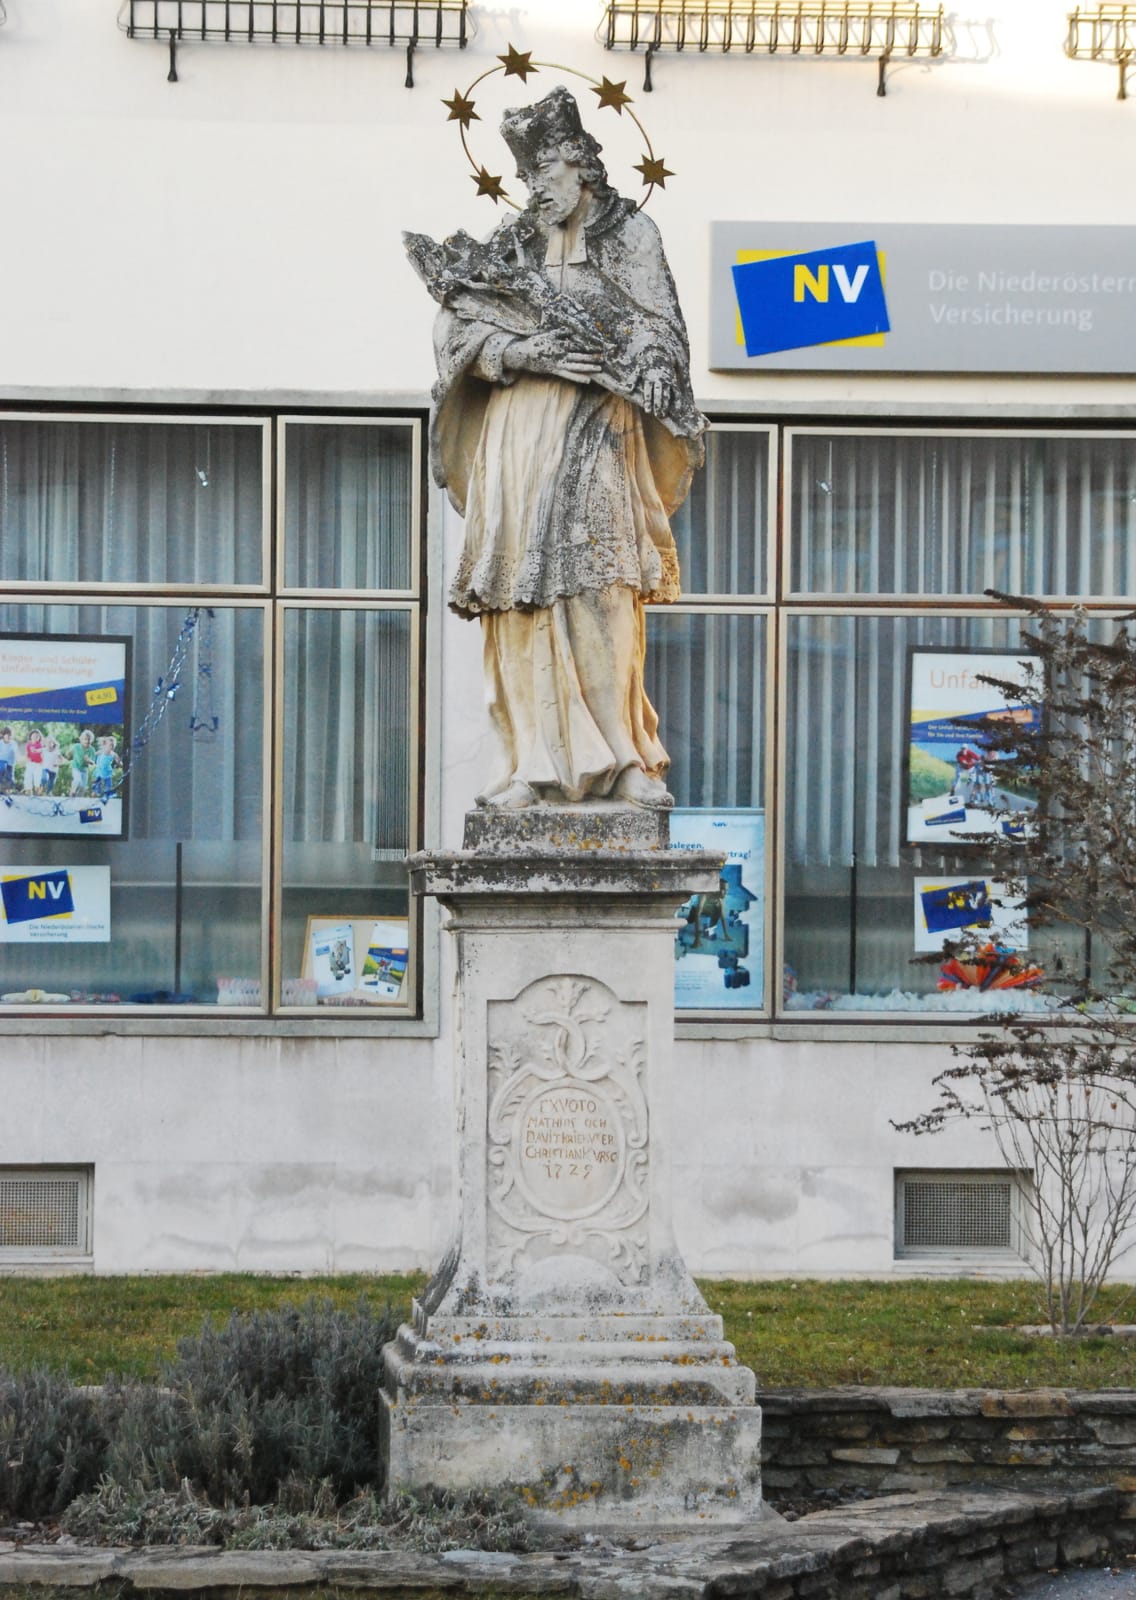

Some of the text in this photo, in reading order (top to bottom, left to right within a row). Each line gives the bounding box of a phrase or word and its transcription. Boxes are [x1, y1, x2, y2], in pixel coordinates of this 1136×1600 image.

[793, 264, 870, 303] NV
[929, 270, 968, 291] Die
[929, 304, 1093, 331] Versicherung
[28, 881, 65, 899] NV
